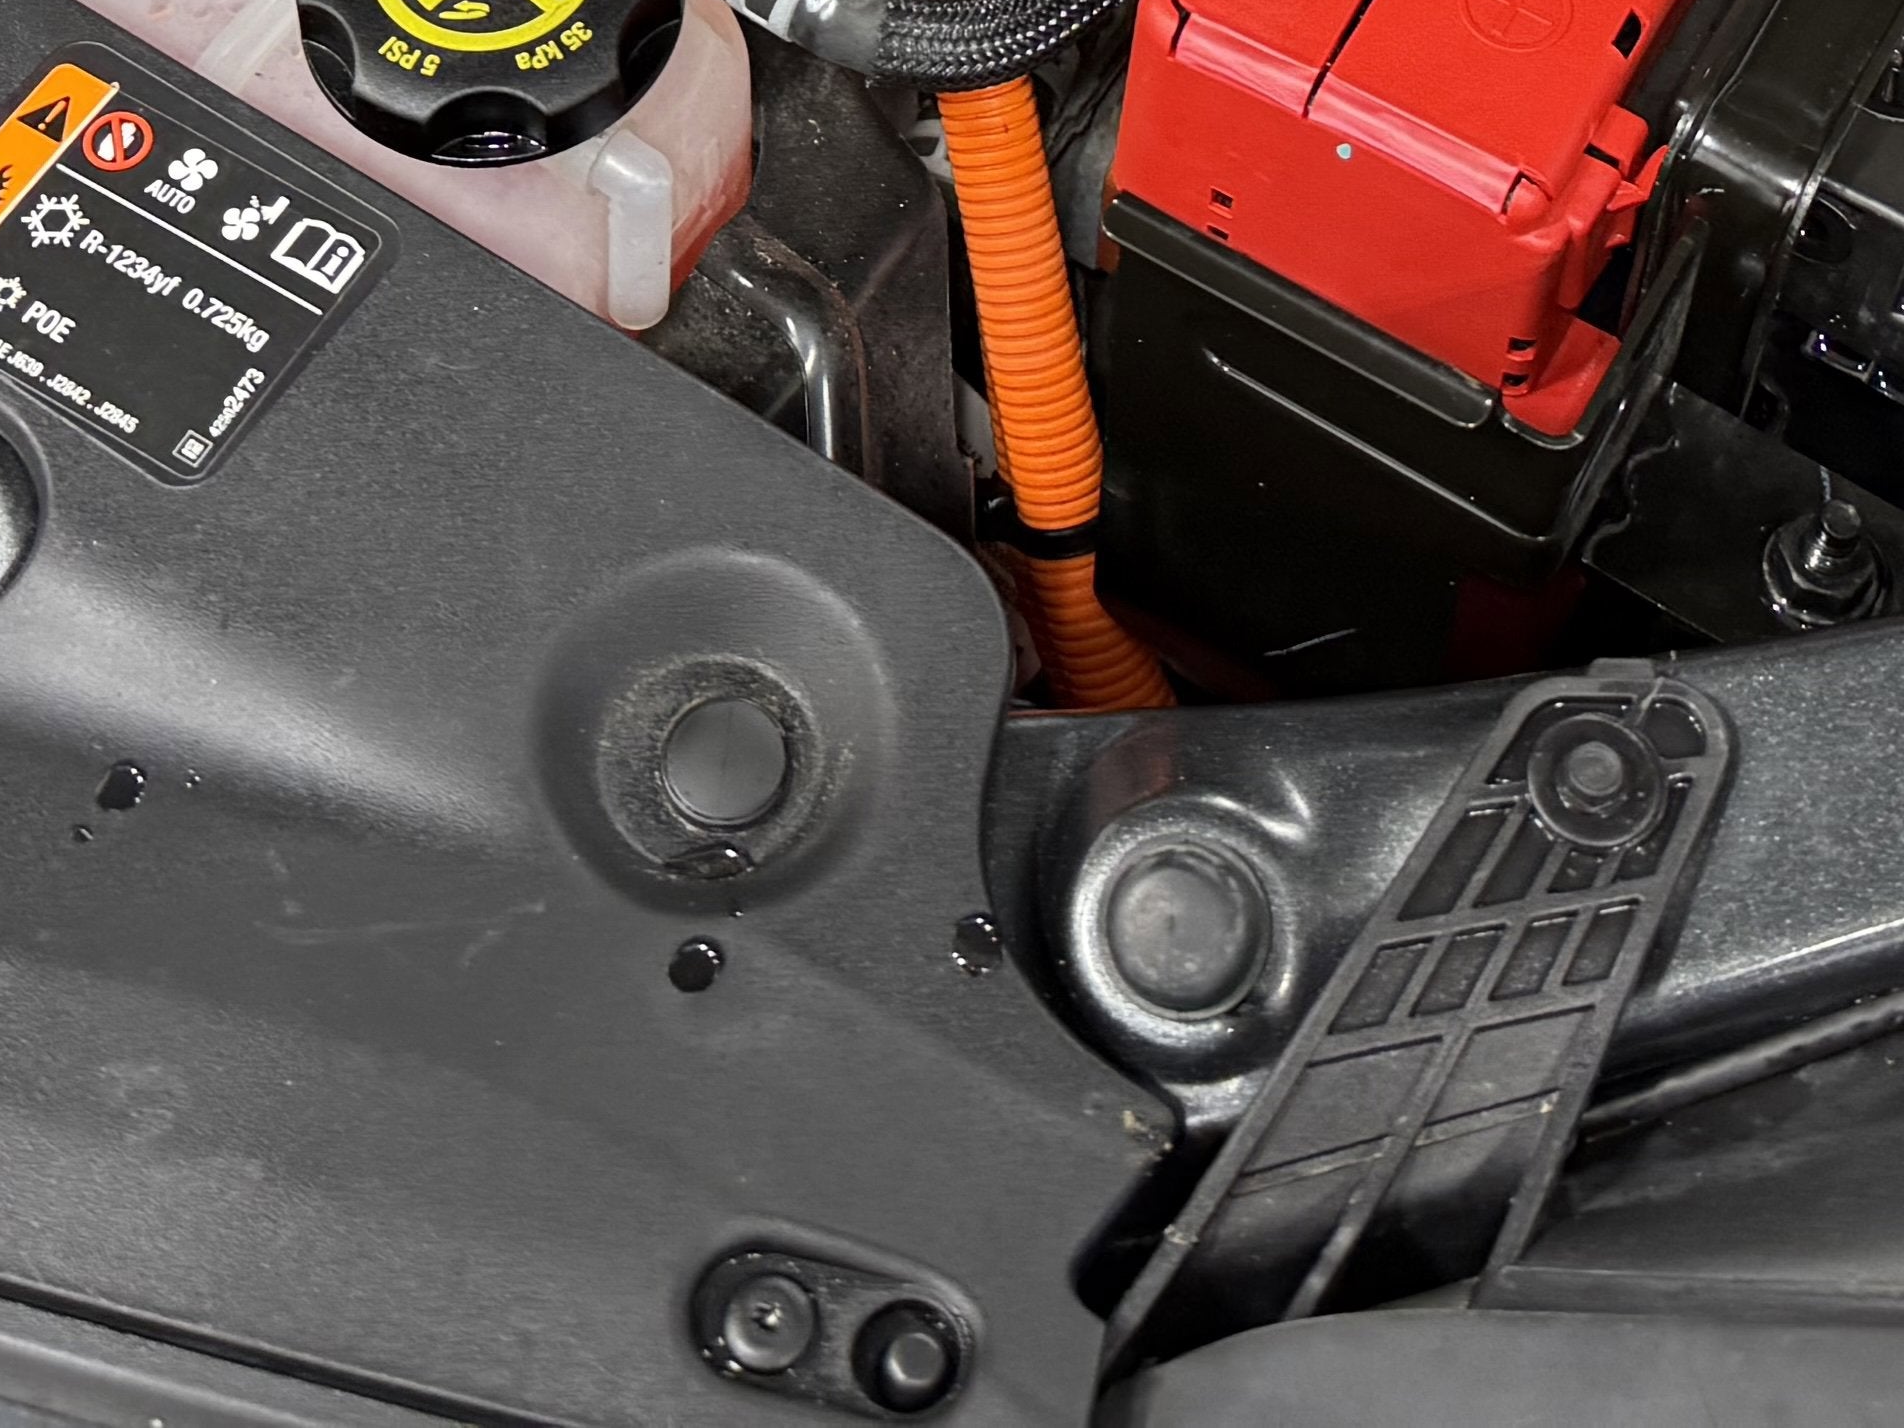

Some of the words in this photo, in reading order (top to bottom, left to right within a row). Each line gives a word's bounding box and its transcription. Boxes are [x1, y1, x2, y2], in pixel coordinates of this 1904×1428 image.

[560, 20, 592, 50] 35
[378, 36, 421, 69] PSI
[420, 54, 440, 76] 5
[514, 40, 563, 69] kPa
[143, 176, 198, 216] AUTO
[74, 227, 184, 302] R-1234yf
[175, 285, 274, 354] 0.725kg
[19, 299, 77, 344] POE
[92, 399, 140, 434] J2845
